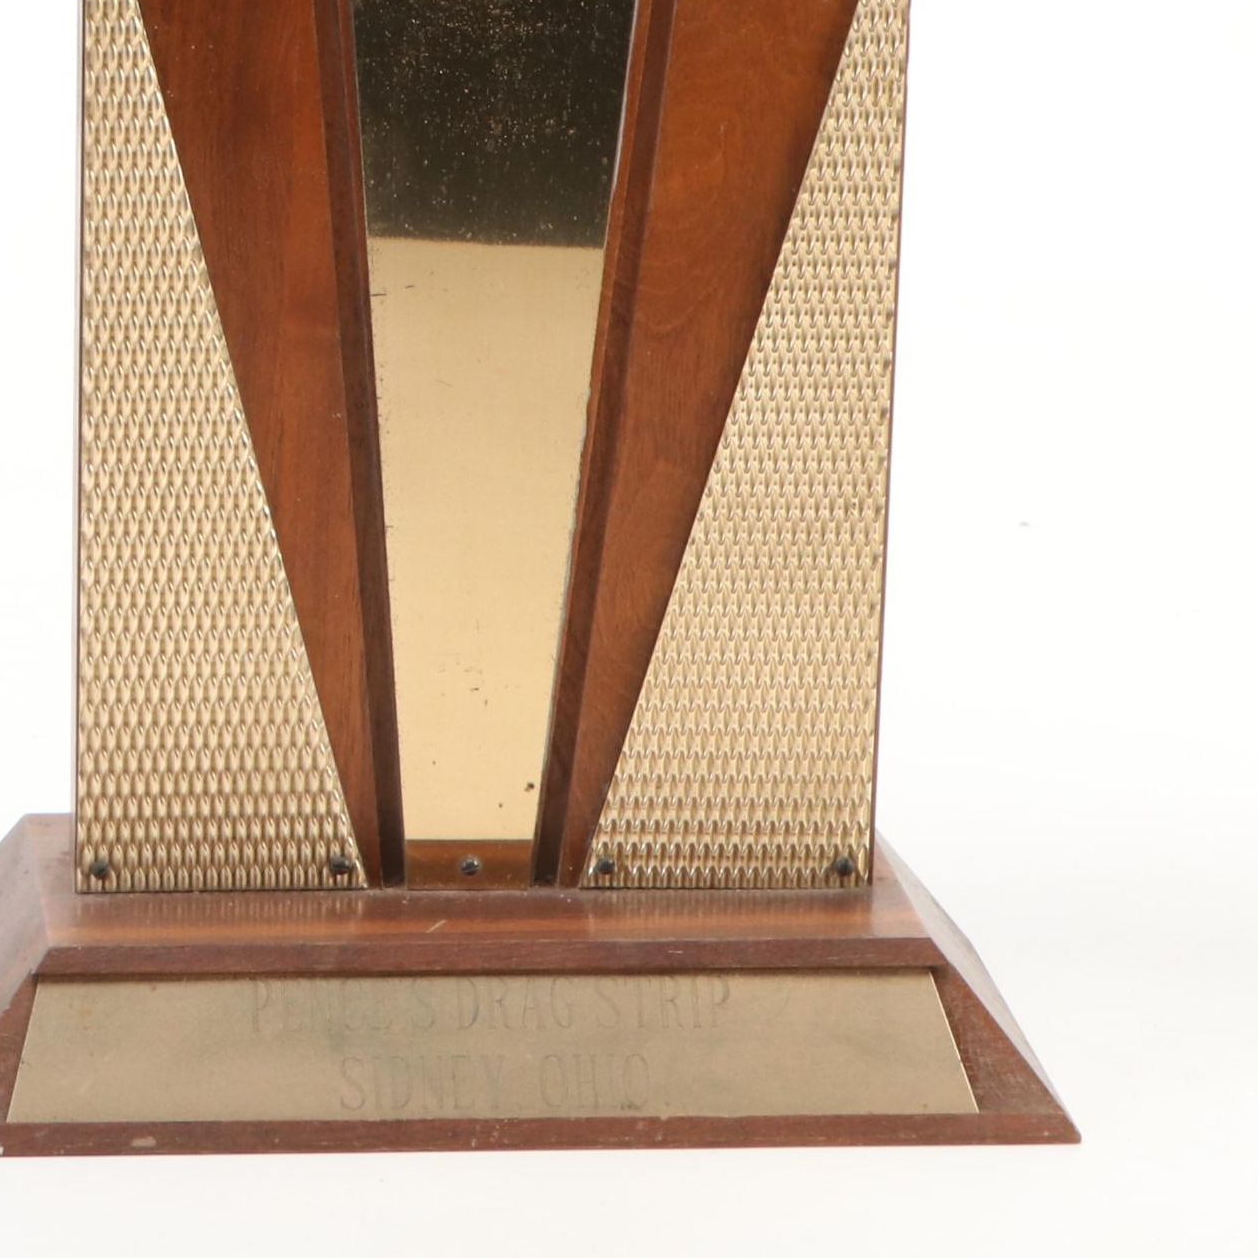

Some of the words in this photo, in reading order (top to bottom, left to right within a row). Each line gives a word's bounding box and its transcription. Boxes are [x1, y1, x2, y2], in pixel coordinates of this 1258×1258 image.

[456, 975, 574, 1030] DRAG
[594, 974, 731, 1030] STRIP
[539, 1053, 651, 1110] OHIO
